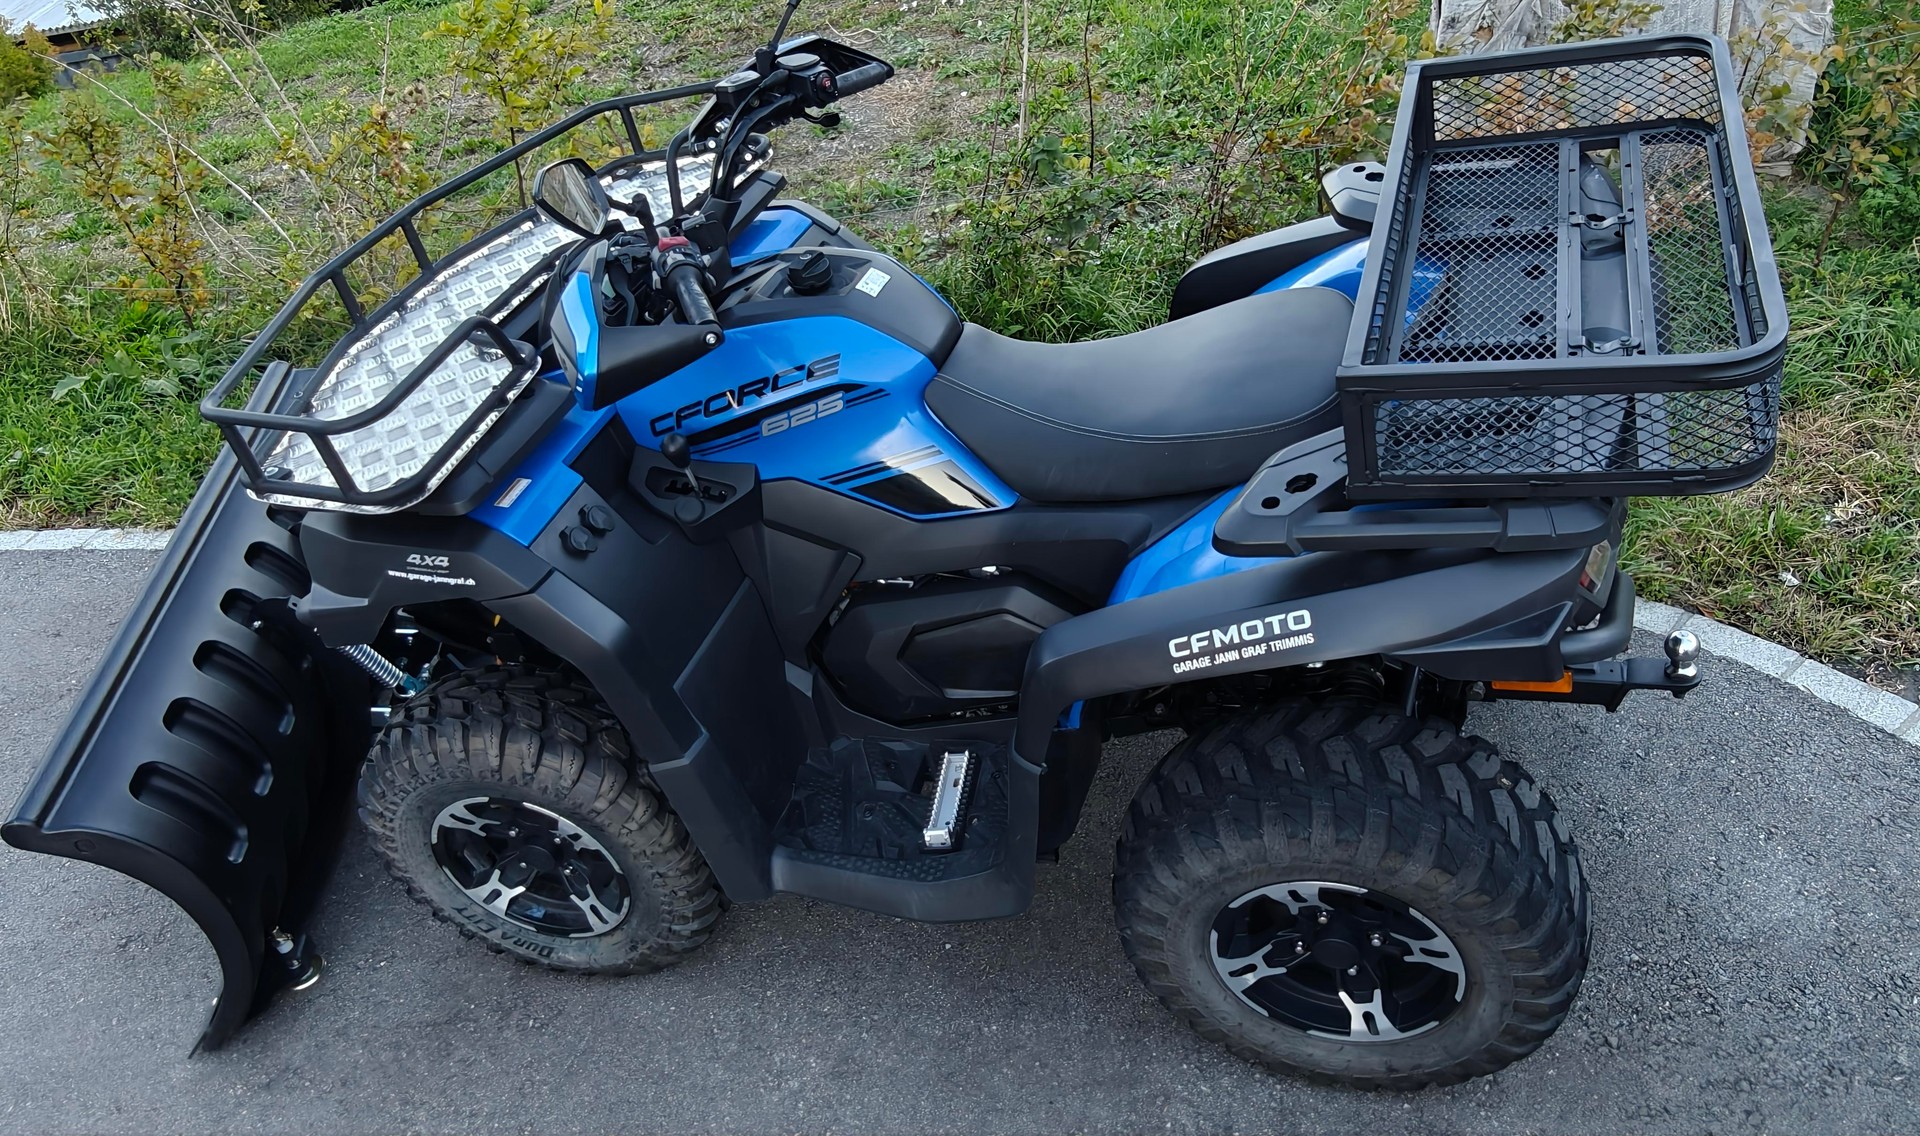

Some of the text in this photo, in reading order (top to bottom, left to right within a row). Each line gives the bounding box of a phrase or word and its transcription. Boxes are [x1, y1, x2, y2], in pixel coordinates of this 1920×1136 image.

[650, 353, 841, 437] CFORCE
[761, 391, 845, 437] 625
[1168, 609, 1312, 658] CFMOTO
[1173, 633, 1315, 674] GARAGE JANN GRAF TRIMMIS
